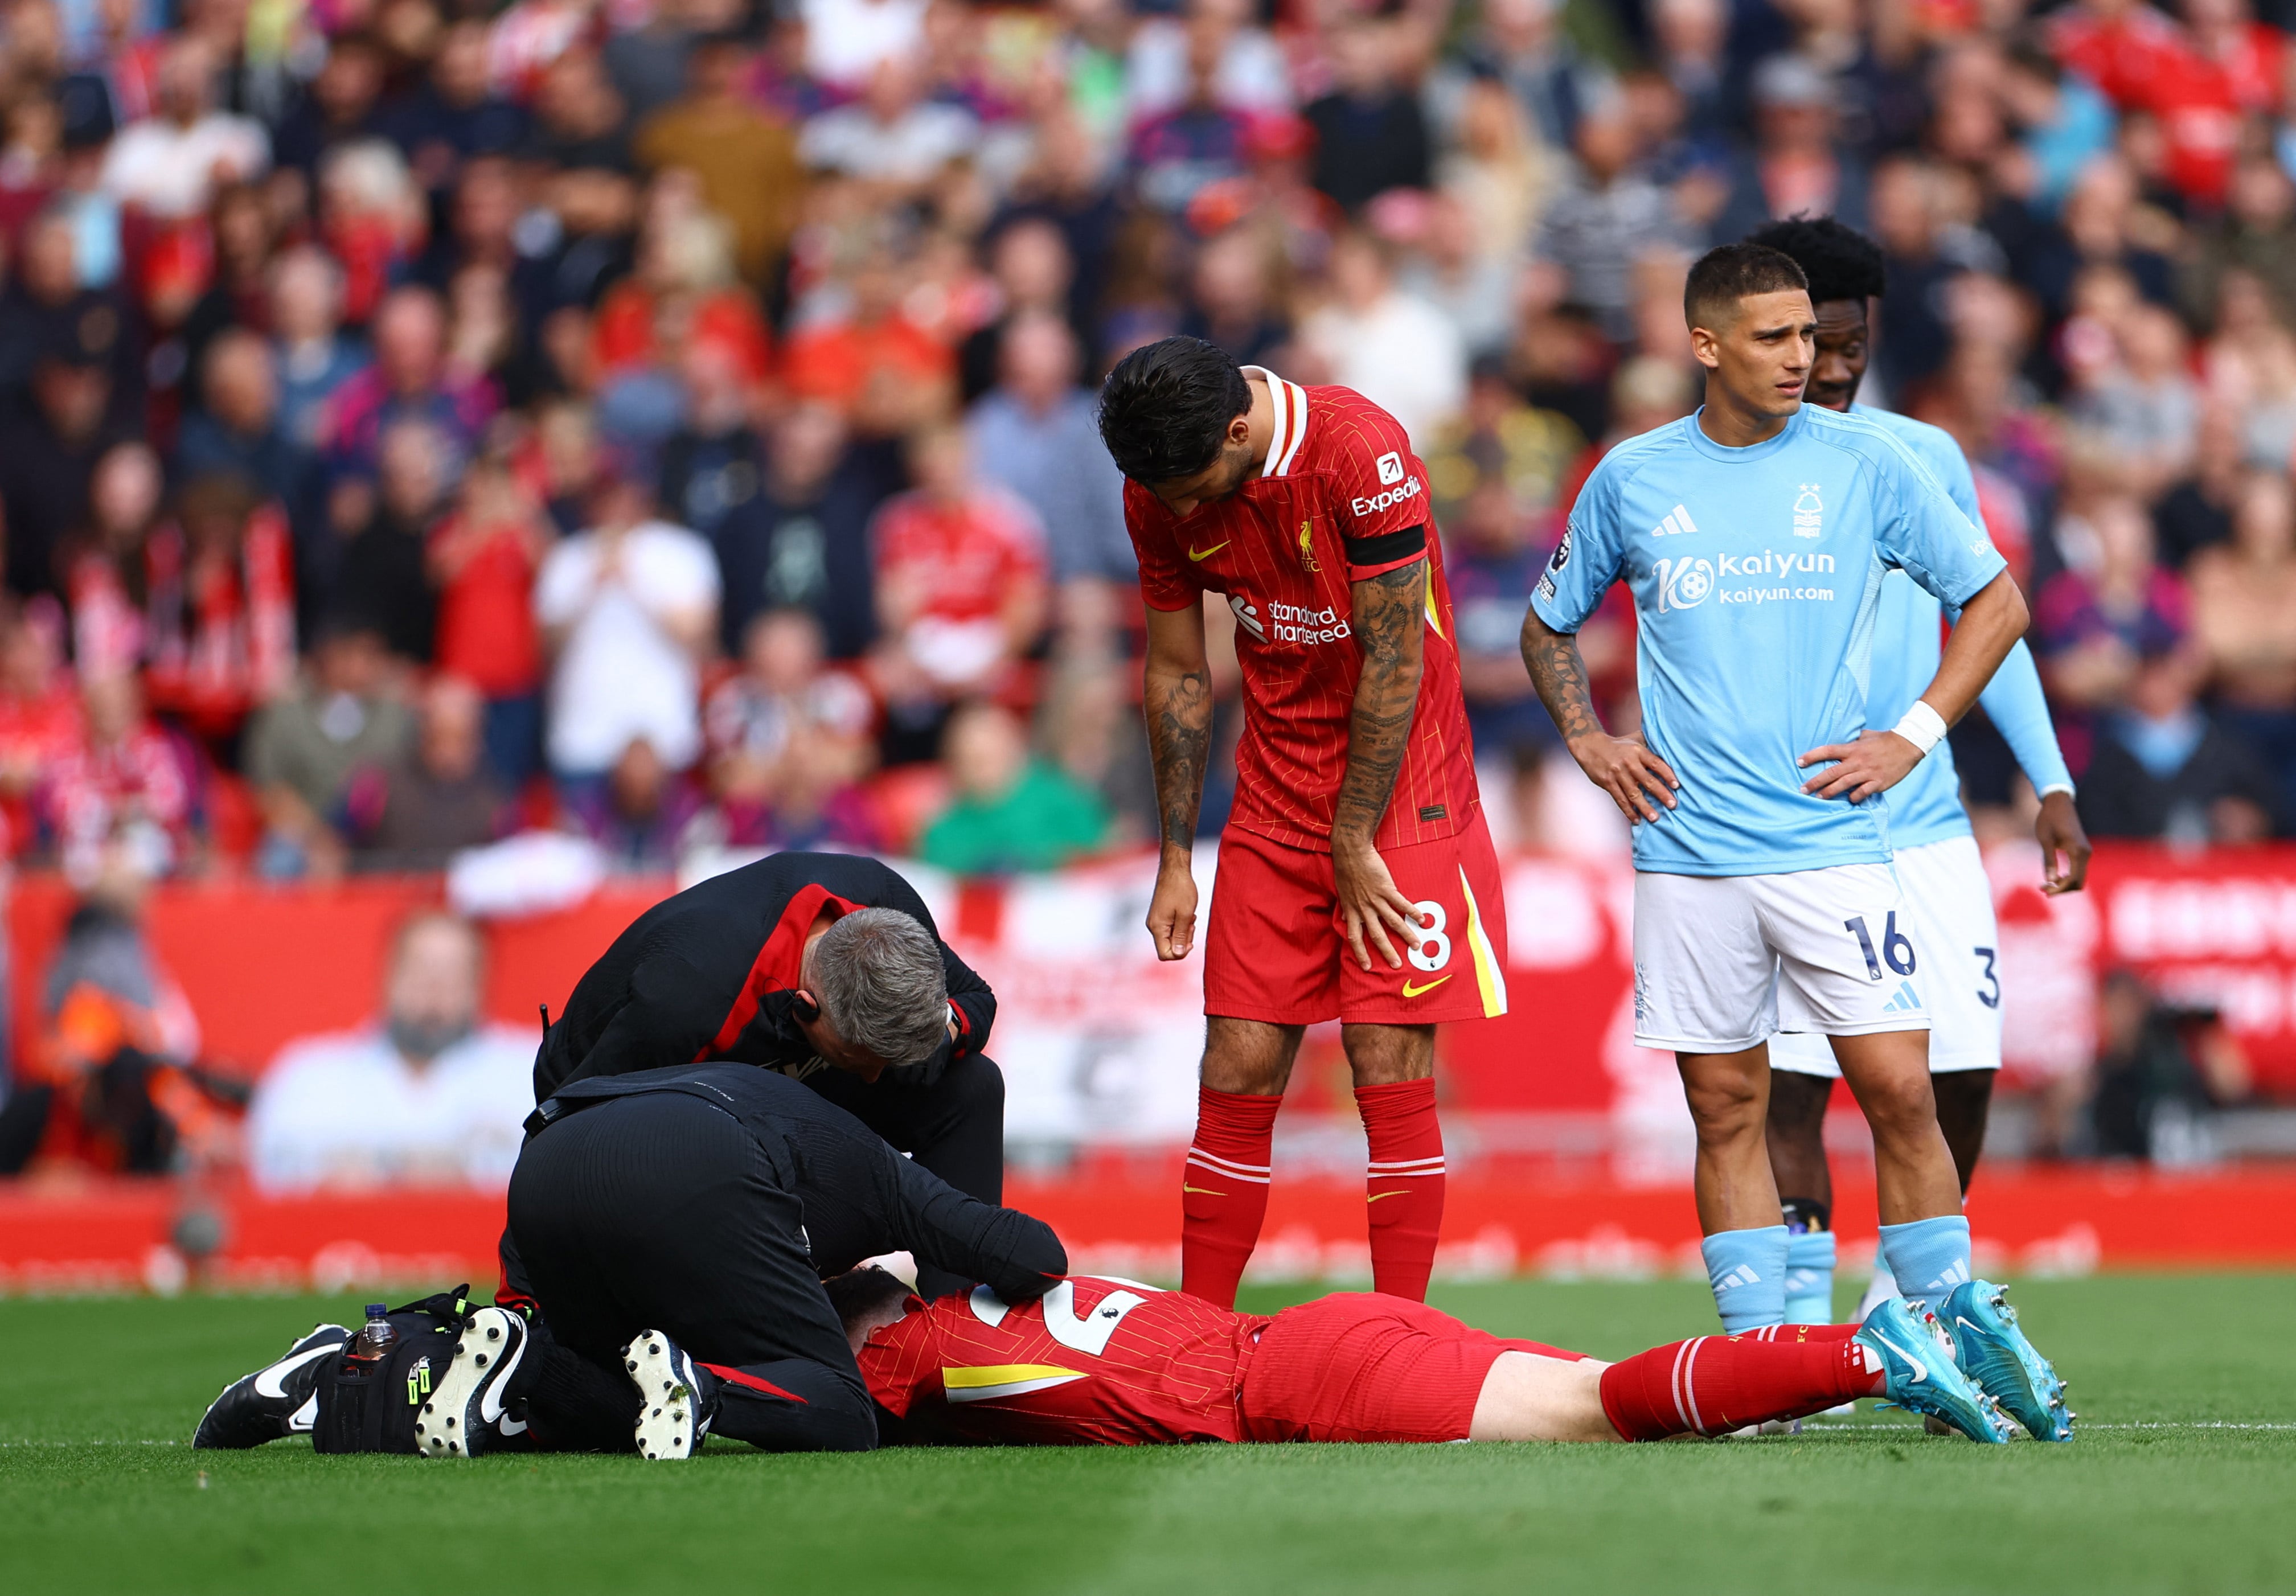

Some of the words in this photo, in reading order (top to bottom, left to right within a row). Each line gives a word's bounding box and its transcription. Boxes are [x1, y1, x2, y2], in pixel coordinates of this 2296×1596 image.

[1352, 475, 1421, 516] Expedia
[1969, 537, 1989, 557] Ide
[1720, 586, 1834, 605] kaiyun.com
[1268, 600, 1337, 626] standard
[1274, 619, 1352, 645] hartered
[1404, 900, 1451, 971] 8
[1844, 910, 1916, 980] 16
[1974, 947, 2000, 1009] 3
[969, 1275, 1167, 1356] 2
[1797, 1325, 1809, 1343] FC
